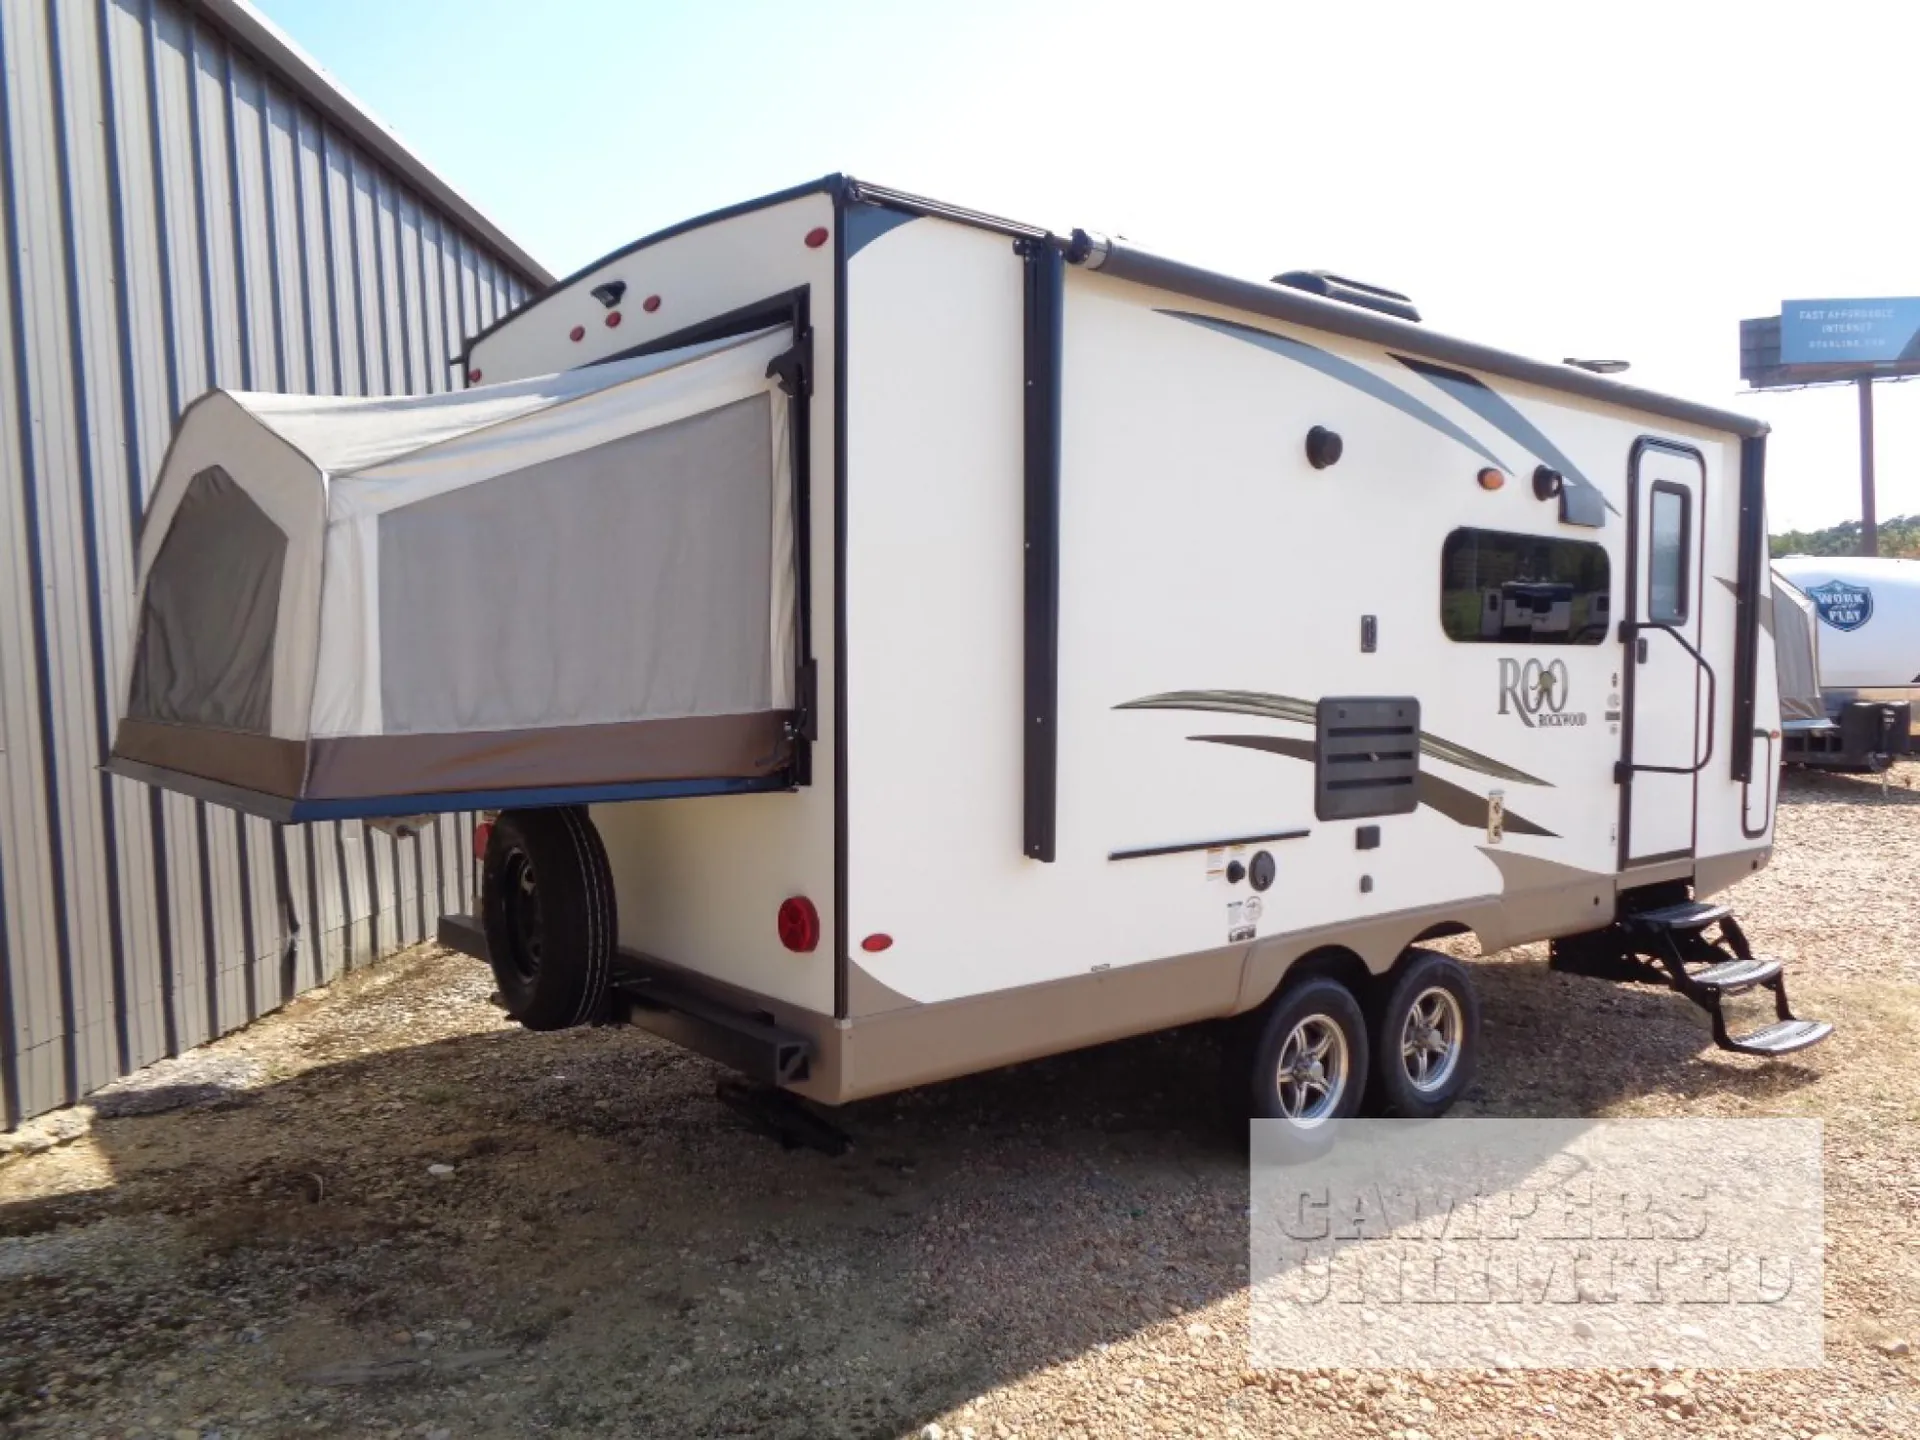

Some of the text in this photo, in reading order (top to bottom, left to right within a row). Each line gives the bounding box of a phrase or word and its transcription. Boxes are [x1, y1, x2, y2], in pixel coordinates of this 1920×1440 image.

[1799, 308, 1895, 320] FAST AFFORDABLE
[1821, 321, 1873, 334] INTERNET
[1816, 593, 1864, 604] WORK
[1828, 609, 1861, 623] PLAY
[1497, 657, 1569, 728] ROO
[1538, 711, 1587, 728] ROCKWOOD
